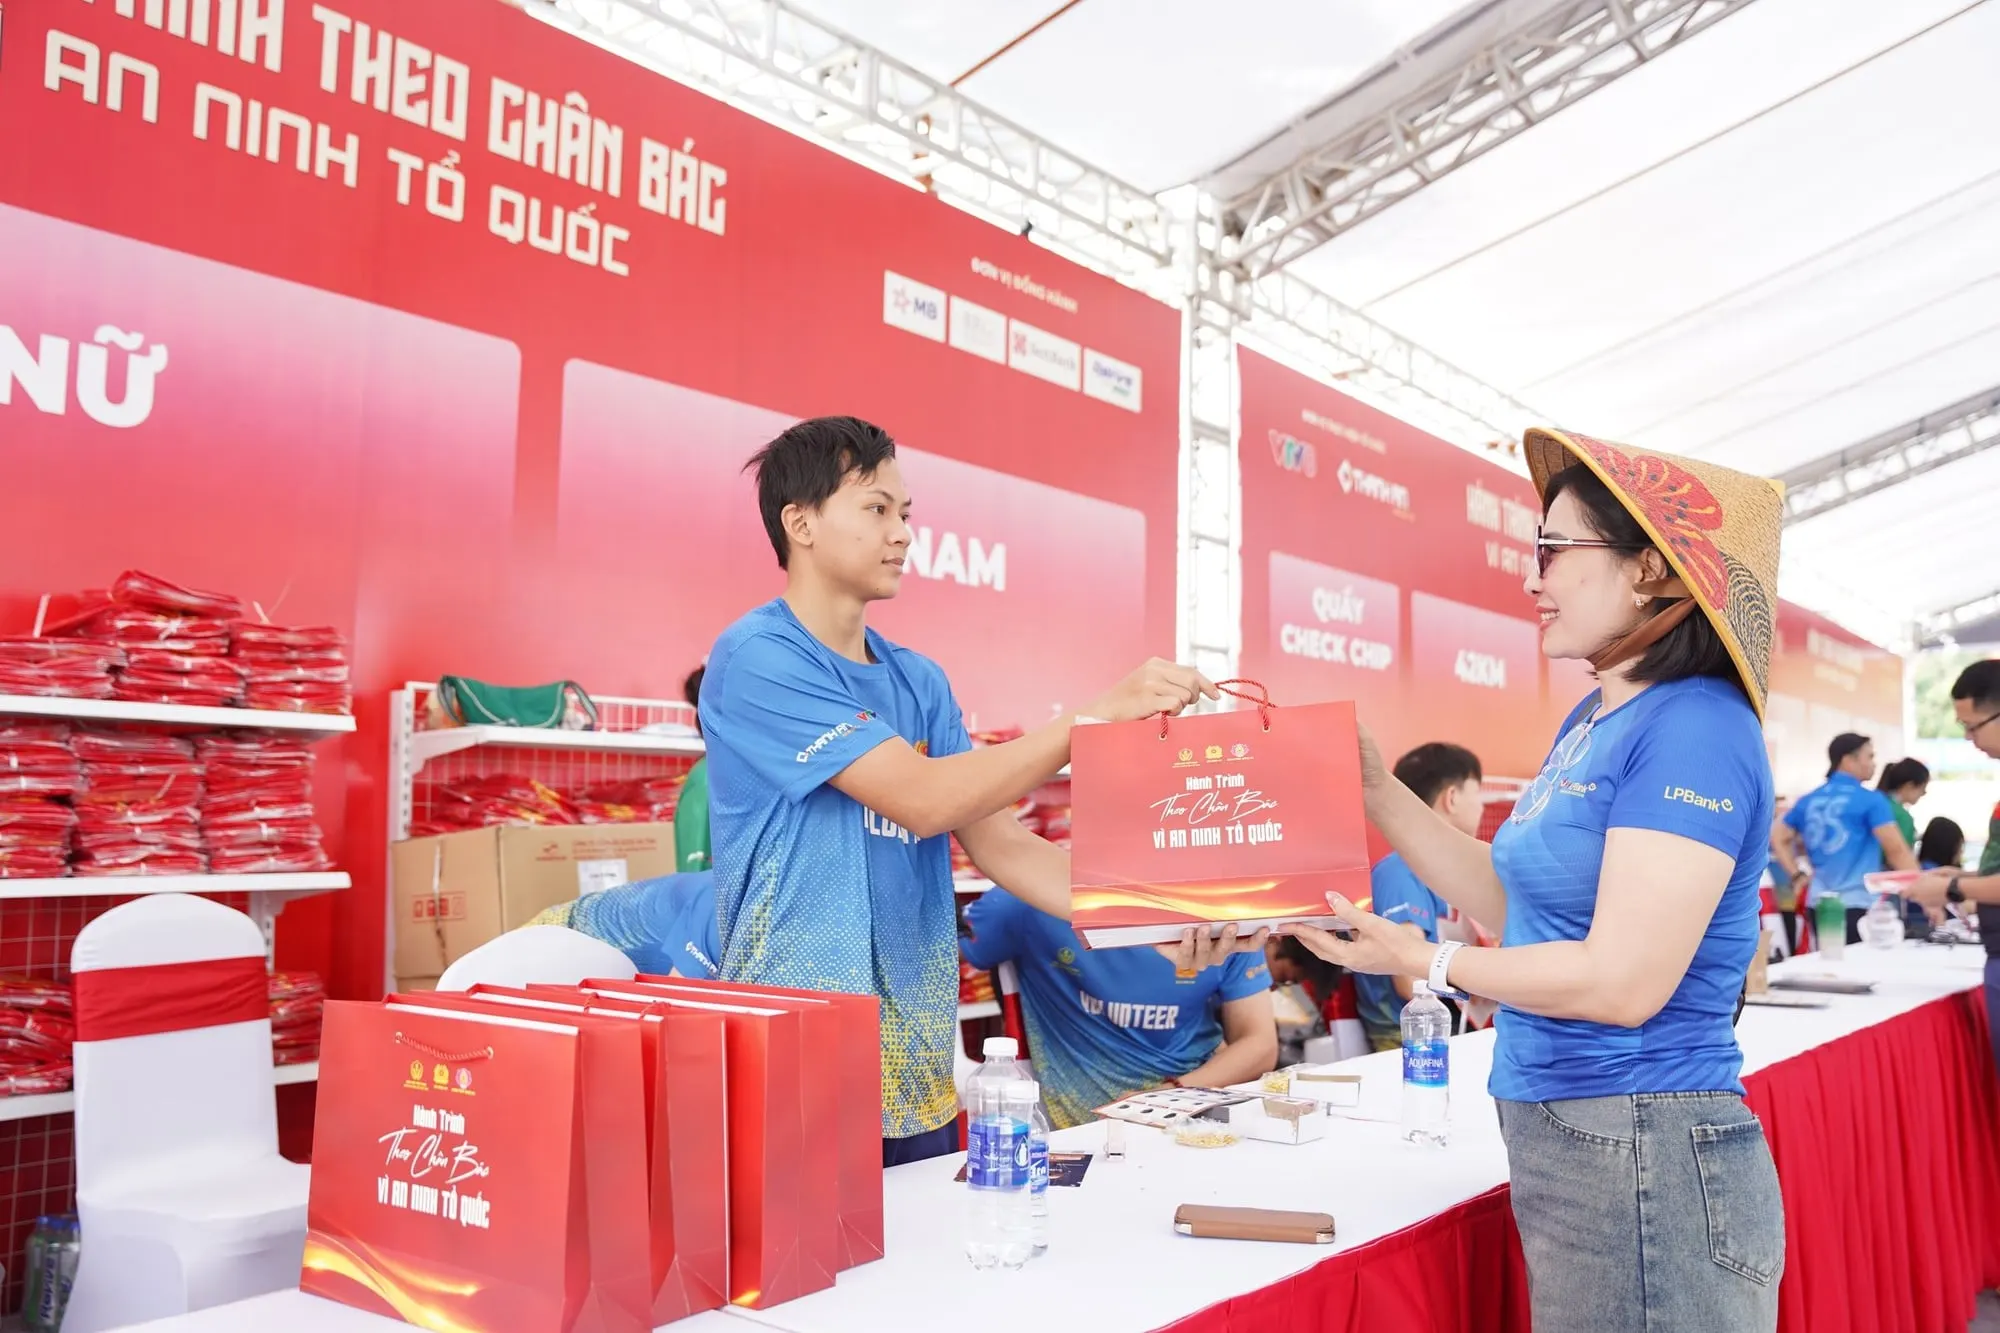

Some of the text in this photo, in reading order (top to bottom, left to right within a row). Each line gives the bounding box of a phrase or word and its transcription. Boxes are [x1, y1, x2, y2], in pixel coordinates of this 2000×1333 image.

[313, 3, 470, 141] THEO
[487, 76, 623, 199] CHÂN
[638, 138, 728, 237] BÁC
[44, 29, 160, 124] AN
[193, 82, 360, 189] NINH
[386, 150, 466, 223] TỔ
[488, 184, 630, 277] QUỐC
[913, 297, 938, 320] MB
[0, 323, 168, 428] NỮ
[903, 523, 1006, 592] NAM
[1280, 623, 1393, 670] CHECK CHIP
[1185, 774, 1245, 790] Hành Trình
[1663, 785, 1720, 813] LPBank
[1150, 789, 1279, 824] Theo Chân Bác
[1153, 818, 1283, 849] VÌ AN NINH TỔ QUỐC
[412, 1103, 465, 1135] Hành Trình
[411, 1133, 448, 1178] Chân
[377, 1173, 389, 1205] VÌ
[391, 1179, 409, 1209] AN
[410, 1183, 439, 1216] NINH
[460, 1191, 490, 1229] QUỐC
